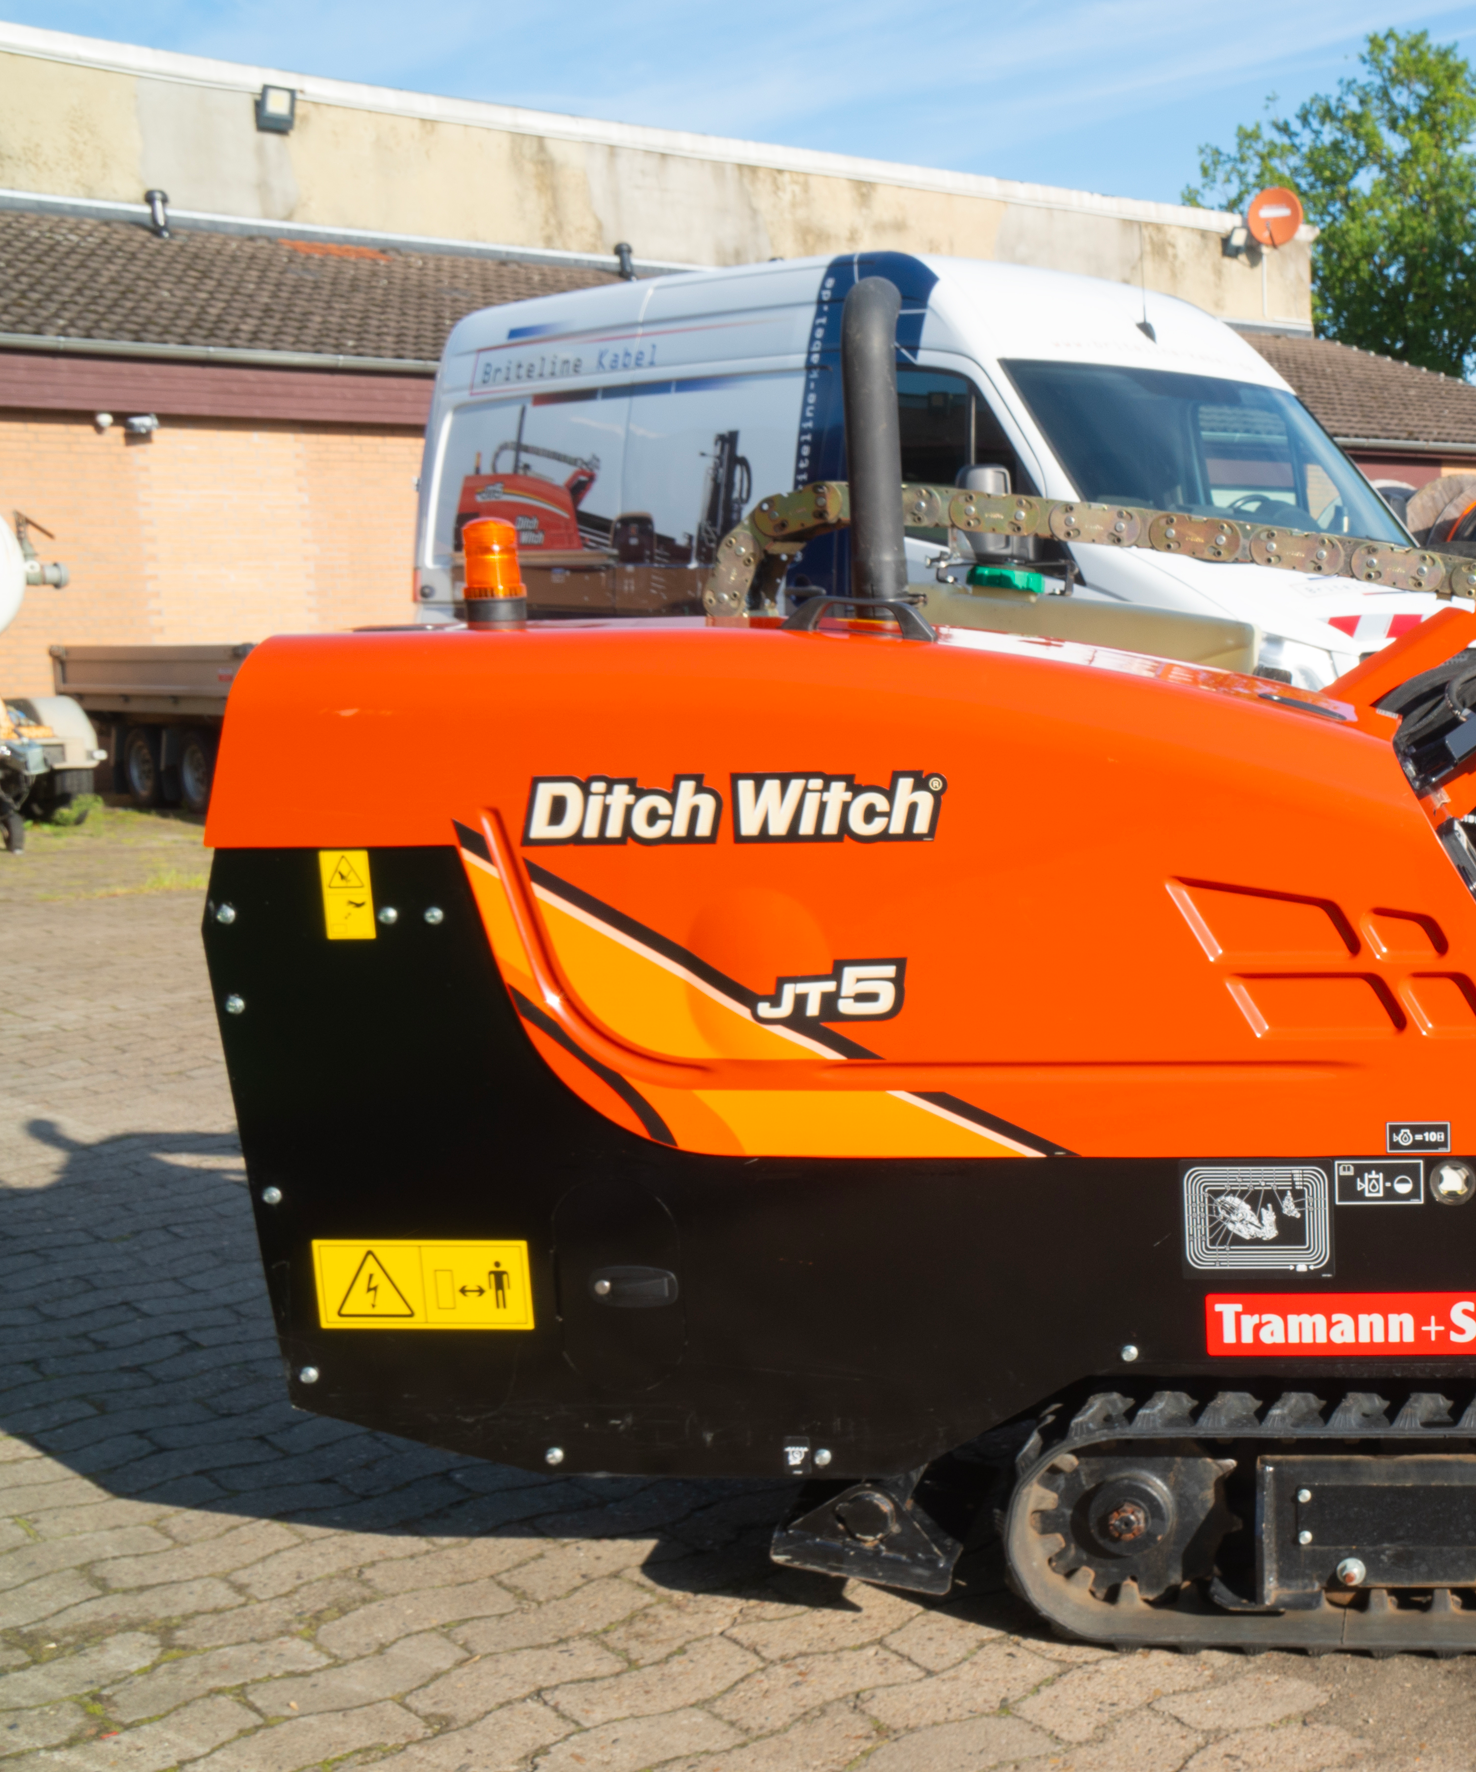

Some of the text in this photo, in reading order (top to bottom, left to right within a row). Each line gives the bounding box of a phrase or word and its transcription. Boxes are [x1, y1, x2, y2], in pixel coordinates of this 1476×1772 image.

[481, 343, 658, 385] Briteline Kabel
[529, 780, 718, 839] Ditch
[757, 965, 897, 1020] JT5
